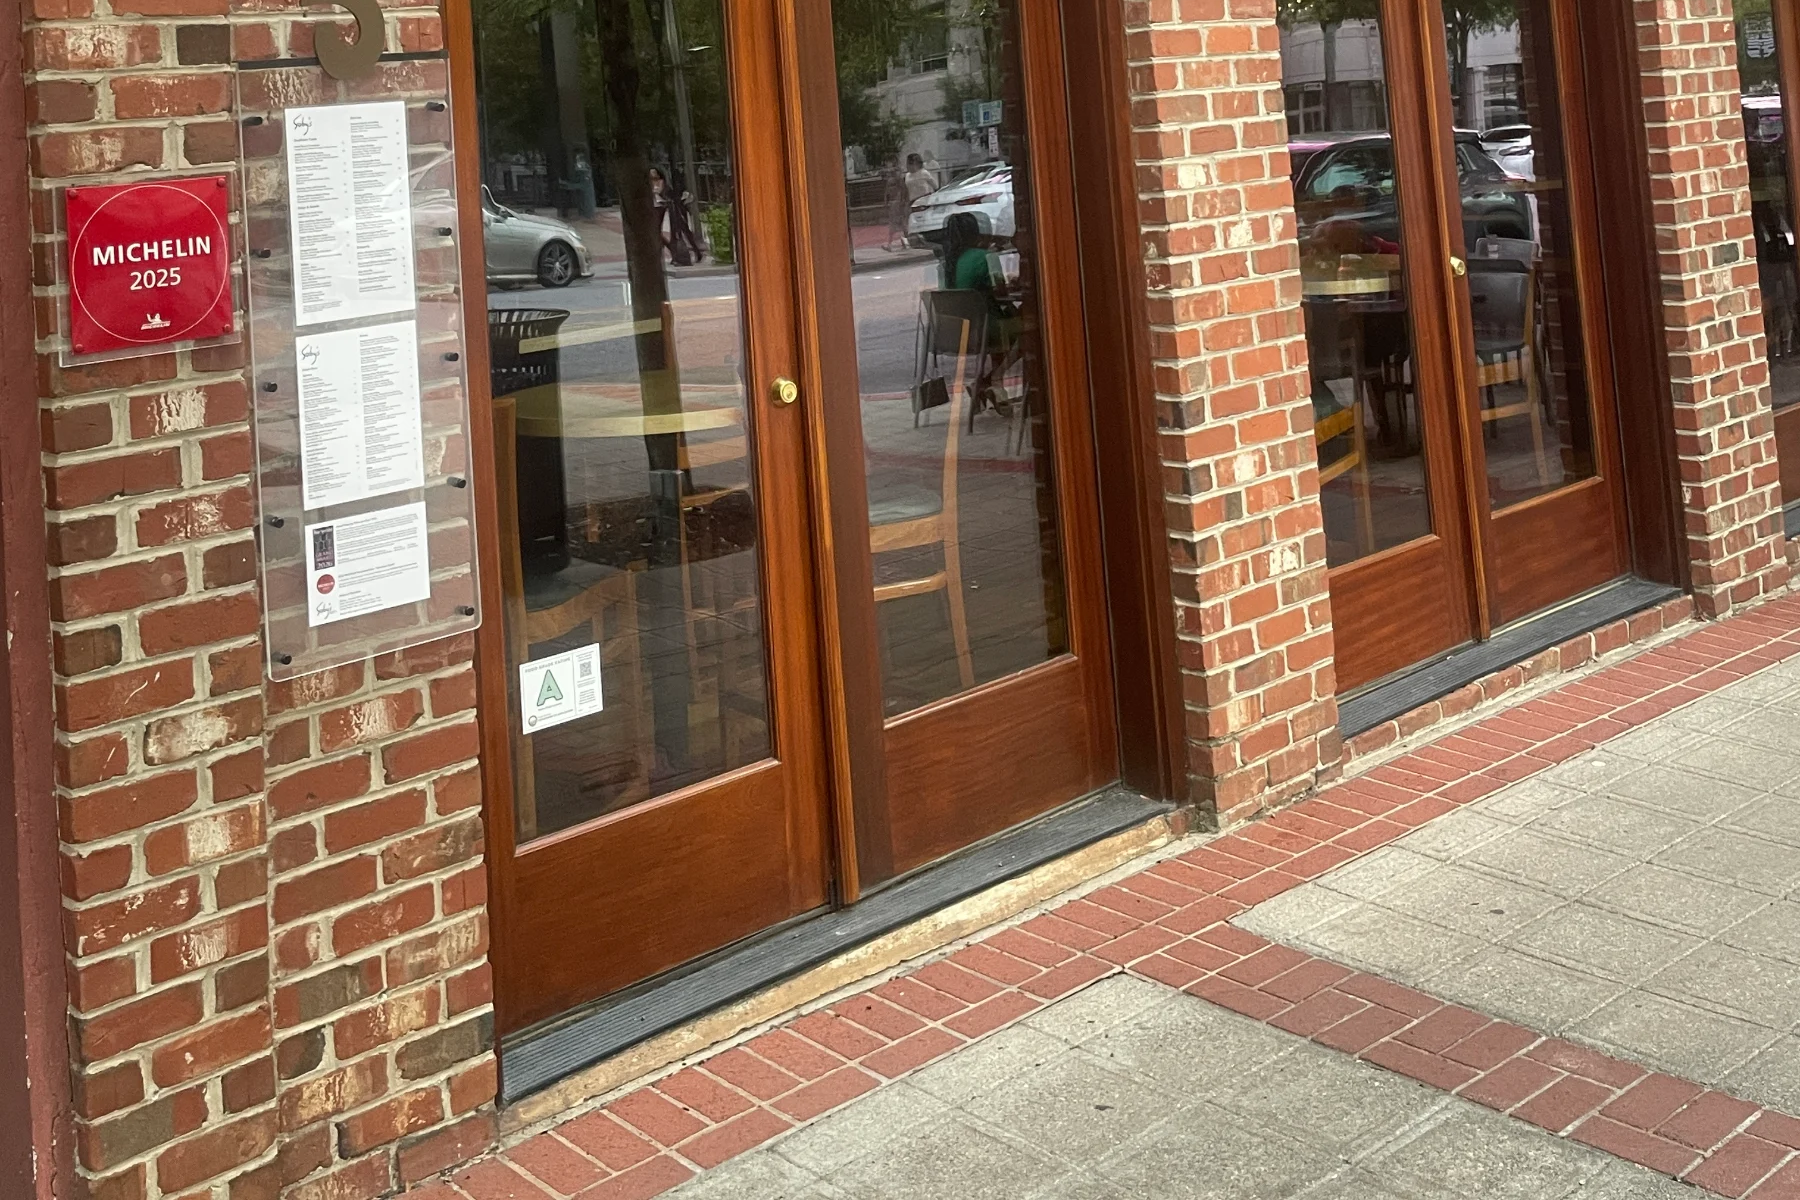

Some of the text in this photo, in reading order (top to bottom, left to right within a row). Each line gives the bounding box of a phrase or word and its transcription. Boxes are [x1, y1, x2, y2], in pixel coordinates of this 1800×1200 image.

[92, 235, 211, 266] MICHELIN
[129, 267, 182, 291] 2025
[537, 669, 564, 707] A
